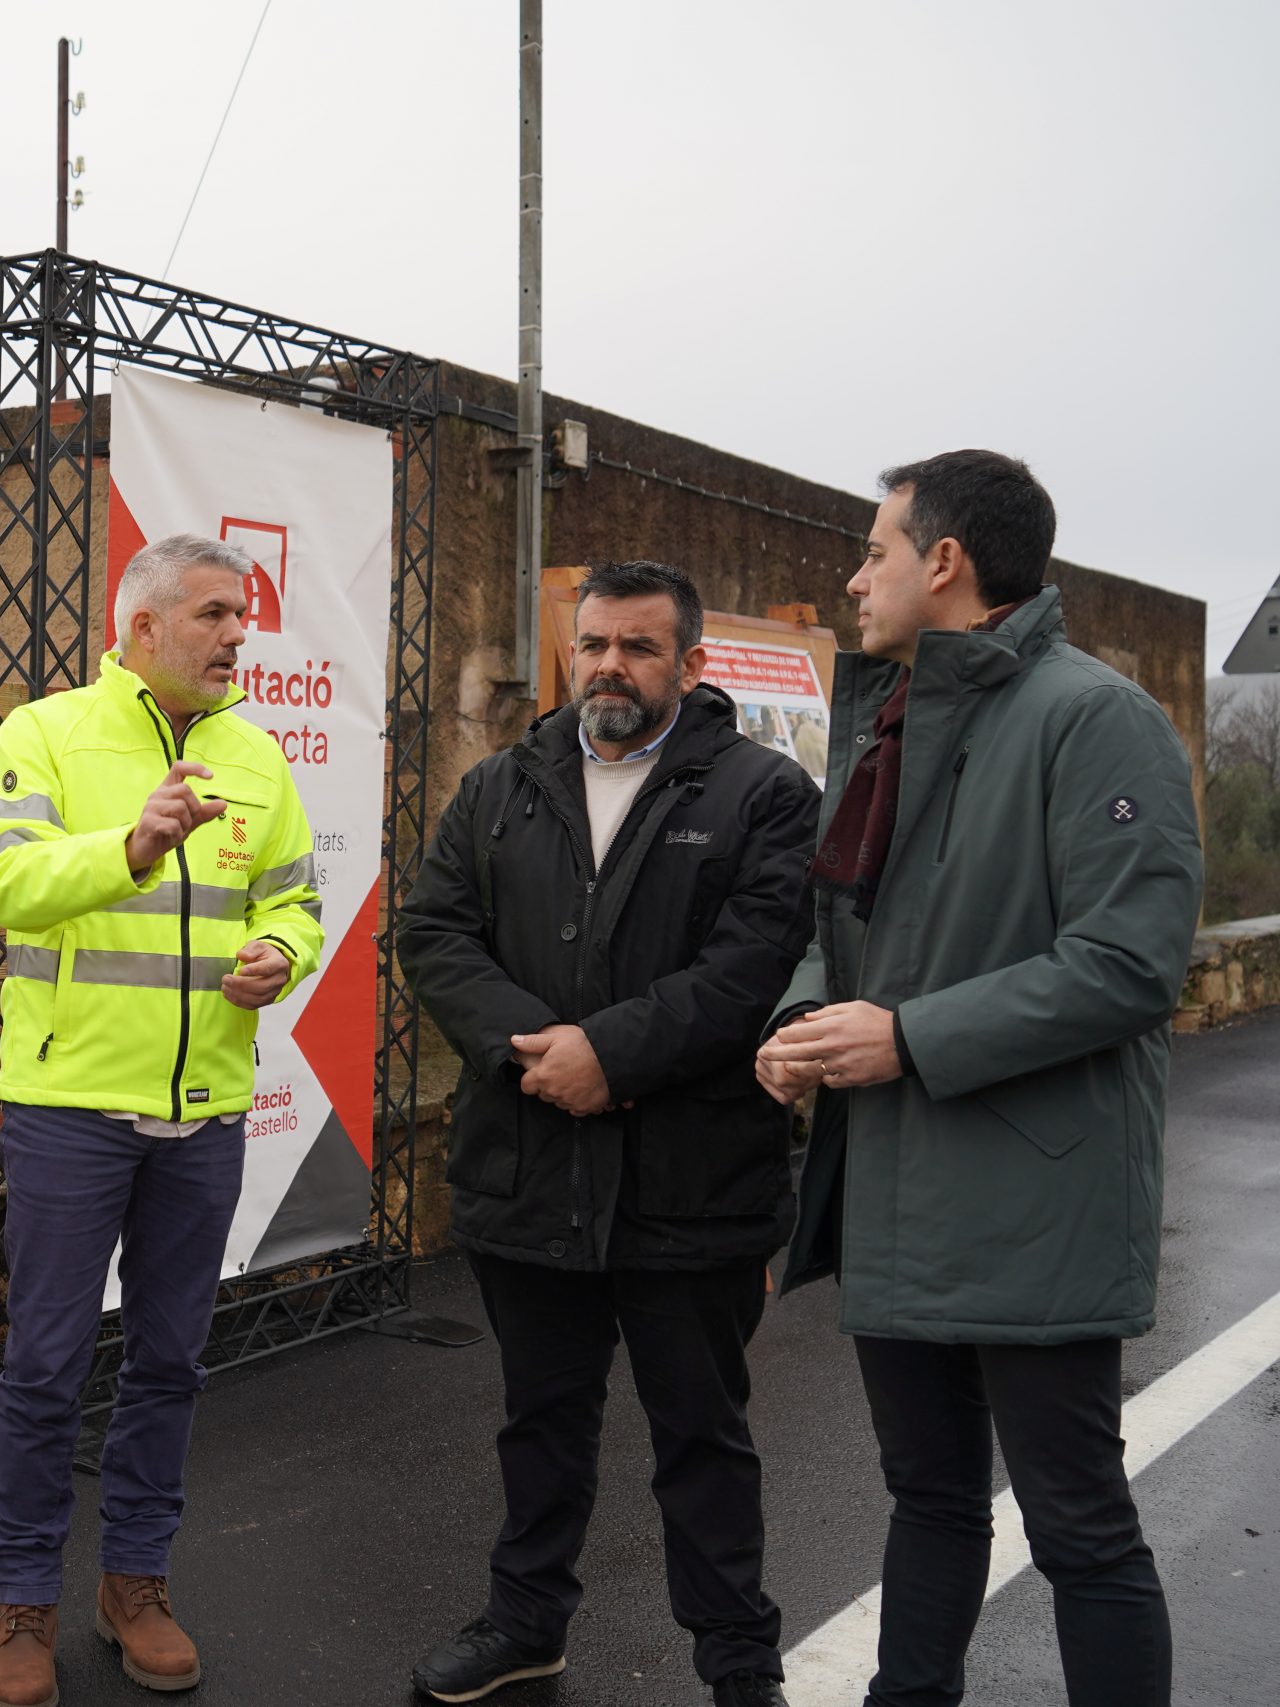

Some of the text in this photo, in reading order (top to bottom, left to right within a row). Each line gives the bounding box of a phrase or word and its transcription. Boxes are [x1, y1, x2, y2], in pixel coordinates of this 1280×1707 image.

[231, 659, 332, 709] utació
[216, 860, 228, 870] de
[218, 848, 255, 861] Diputació
[247, 1084, 292, 1113] tació
